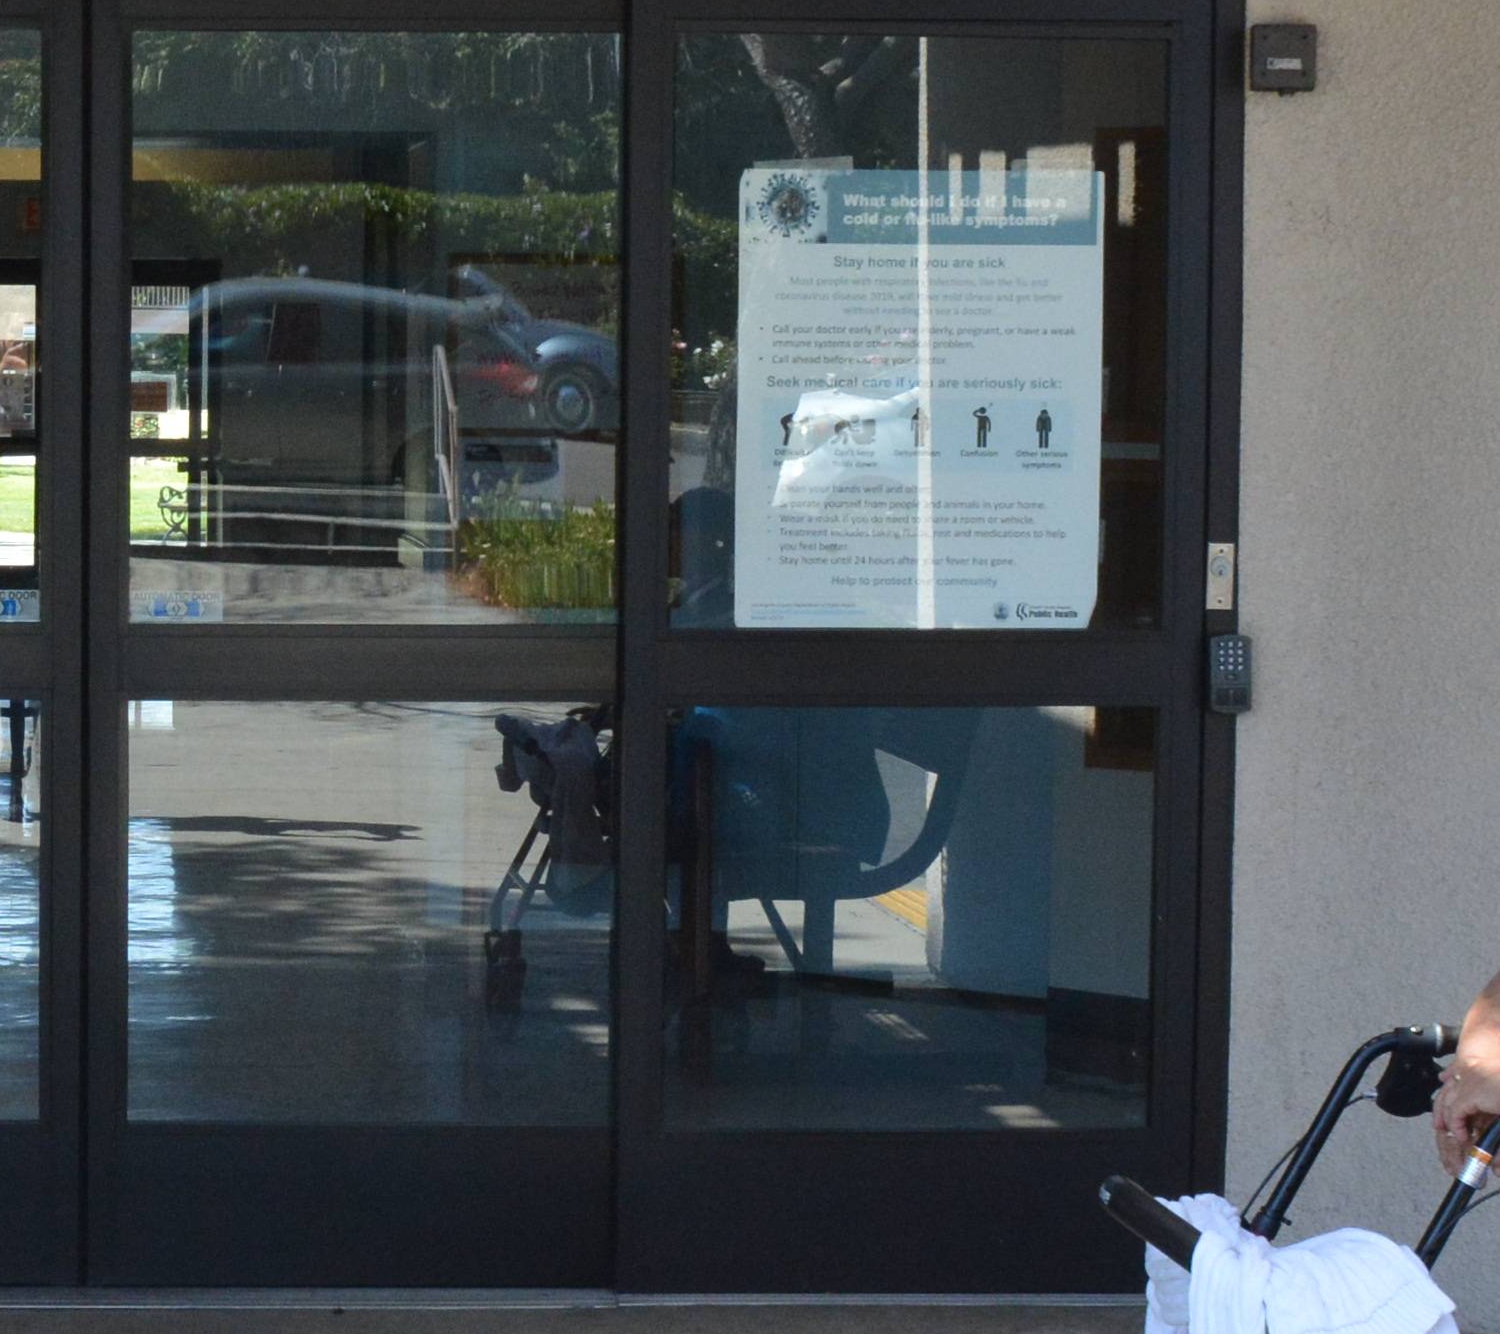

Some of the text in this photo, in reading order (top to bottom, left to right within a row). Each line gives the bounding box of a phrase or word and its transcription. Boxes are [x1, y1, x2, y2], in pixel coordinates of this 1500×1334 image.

[843, 194, 886, 208] What
[960, 195, 981, 208] do
[1012, 195, 1050, 209] have
[843, 212, 878, 226] cold
[883, 215, 900, 226] or
[965, 213, 1058, 228] symptoms?
[833, 255, 863, 269] Stay
[868, 255, 908, 268] home
[953, 259, 974, 268] are
[978, 256, 1006, 269] sick
[772, 324, 1075, 336] Call your doctor early have weak
[772, 339, 851, 350] immune systems
[772, 355, 790, 364] Call
[791, 355, 822, 364] ahead
[823, 355, 853, 364] before
[766, 375, 1063, 392] Seek care if are seriously sick:
[960, 449, 1068, 458] Confusion Other serious
[885, 484, 903, 493] and
[823, 499, 1015, 511] yourself from animals your
[870, 515, 882, 524] do
[885, 515, 909, 524] need
[954, 529, 972, 538] and
[974, 529, 1031, 538] medications
[1046, 529, 1067, 539] help
[780, 556, 988, 566] Stay home until 24 hours fever has
[832, 576, 998, 588] Help to protect community
[9, 591, 38, 600] DOOR
